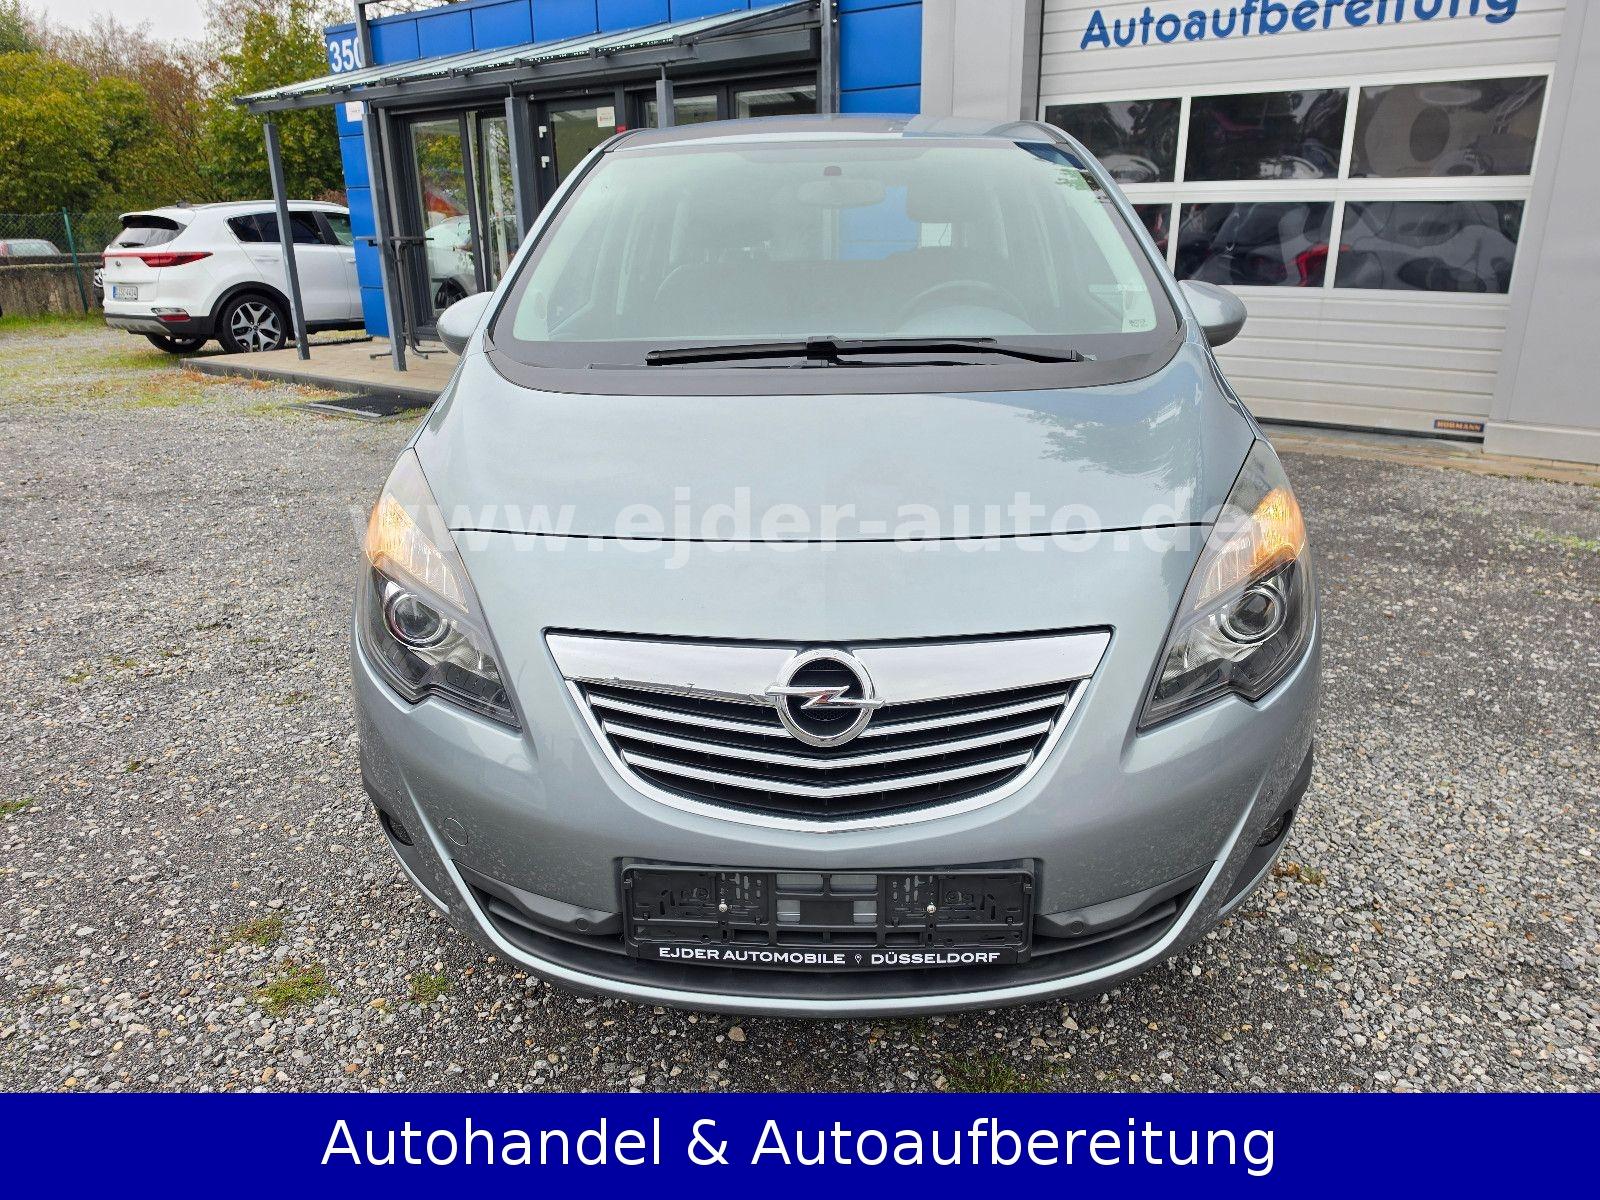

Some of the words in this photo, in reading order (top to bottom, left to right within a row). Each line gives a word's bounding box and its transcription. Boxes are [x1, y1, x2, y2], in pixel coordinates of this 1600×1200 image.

[659, 947, 719, 960] EJDER
[722, 950, 846, 965] AUTOMOBILE
[871, 951, 1001, 965] DÜSSELDORF
